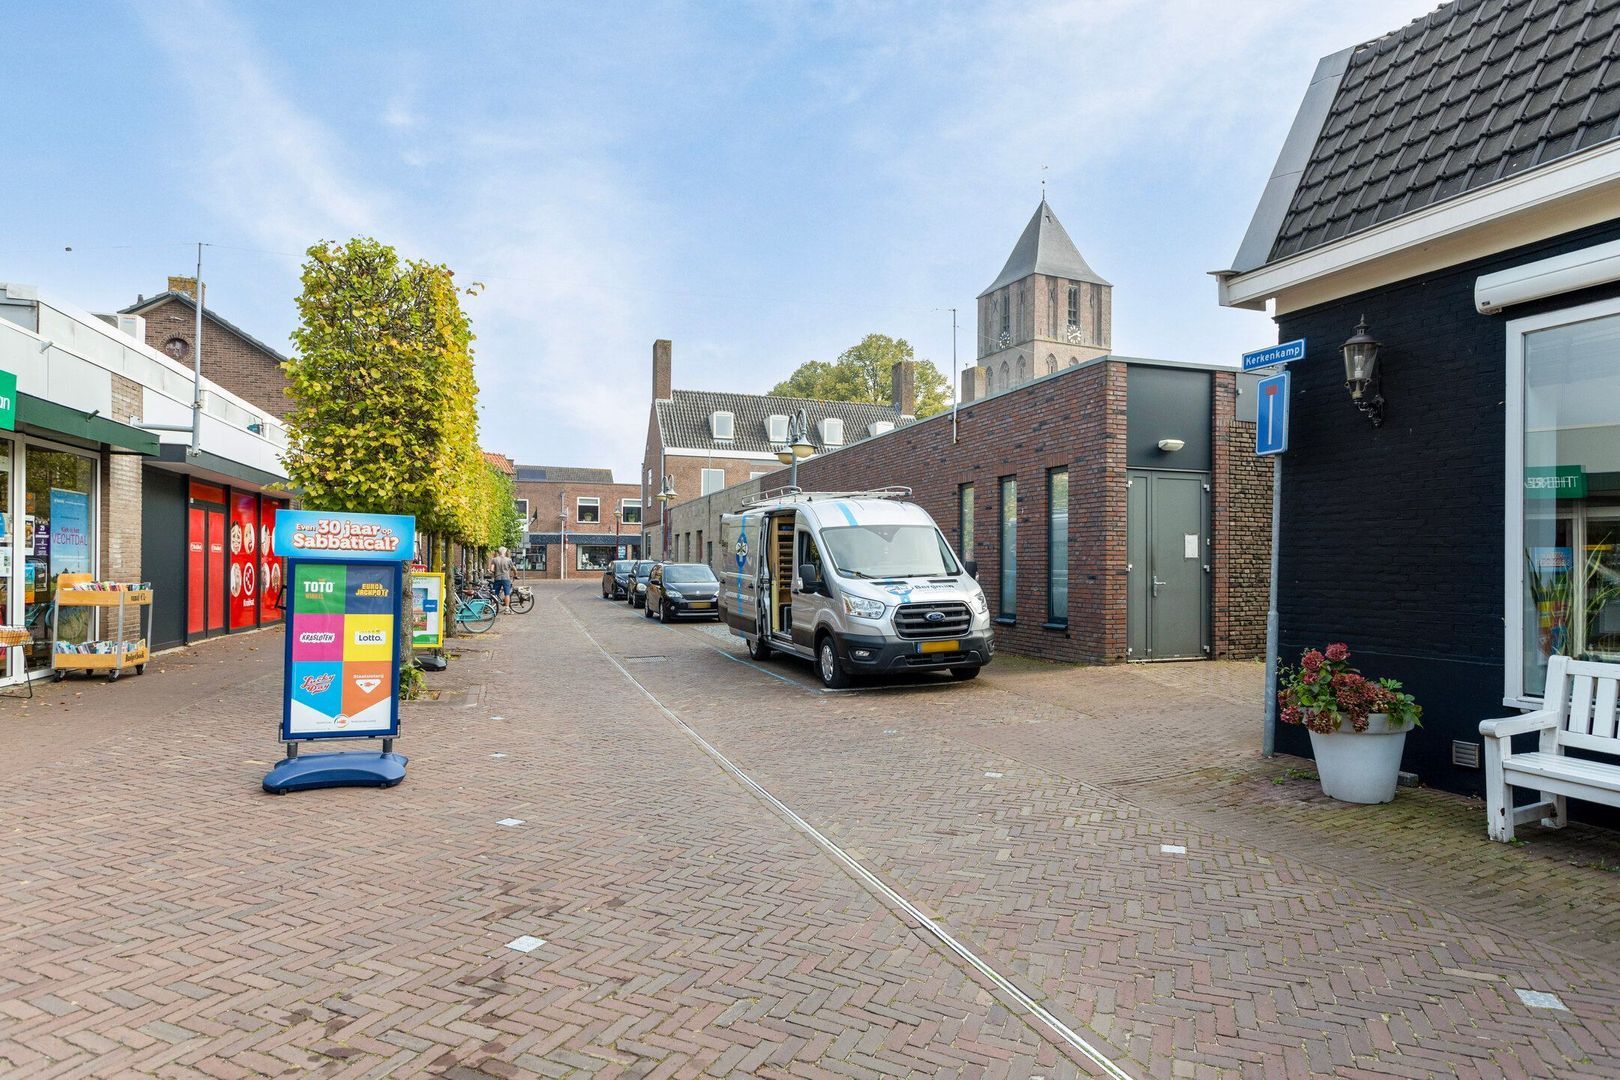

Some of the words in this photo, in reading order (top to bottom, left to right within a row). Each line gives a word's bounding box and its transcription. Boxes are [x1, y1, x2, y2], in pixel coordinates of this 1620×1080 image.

[1246, 346, 1300, 366] Kerkenkamp
[296, 523, 316, 532] Even
[318, 519, 340, 535] 30
[344, 520, 380, 537] jaar
[53, 533, 88, 546] VECHTDAL
[293, 533, 400, 551] Sabbatical?
[304, 581, 333, 592] TOTO
[301, 633, 333, 641] KRASLOTEN
